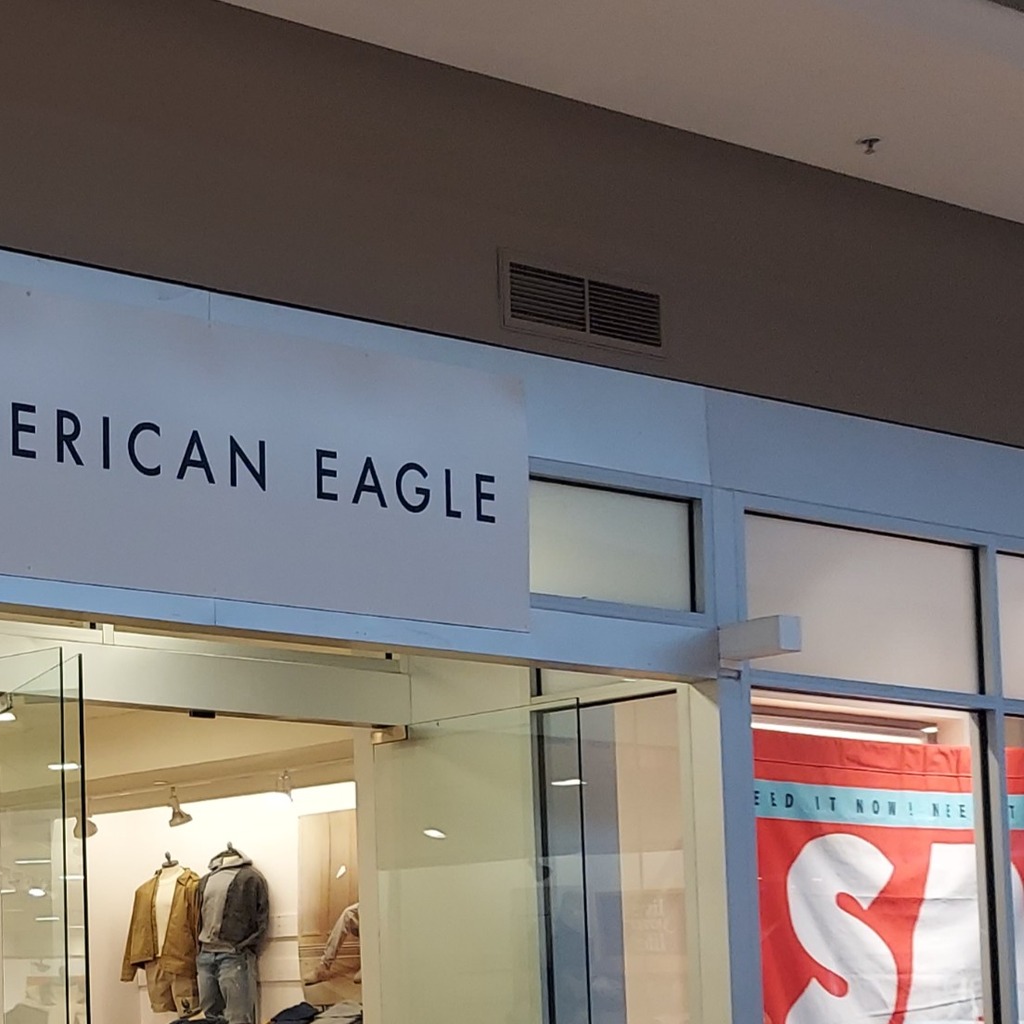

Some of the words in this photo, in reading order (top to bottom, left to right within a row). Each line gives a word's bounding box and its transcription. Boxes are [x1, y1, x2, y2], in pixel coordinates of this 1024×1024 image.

[316, 448, 496, 523] EAGLE
[815, 796, 837, 812] IT
[856, 798, 913, 816] NOW!
